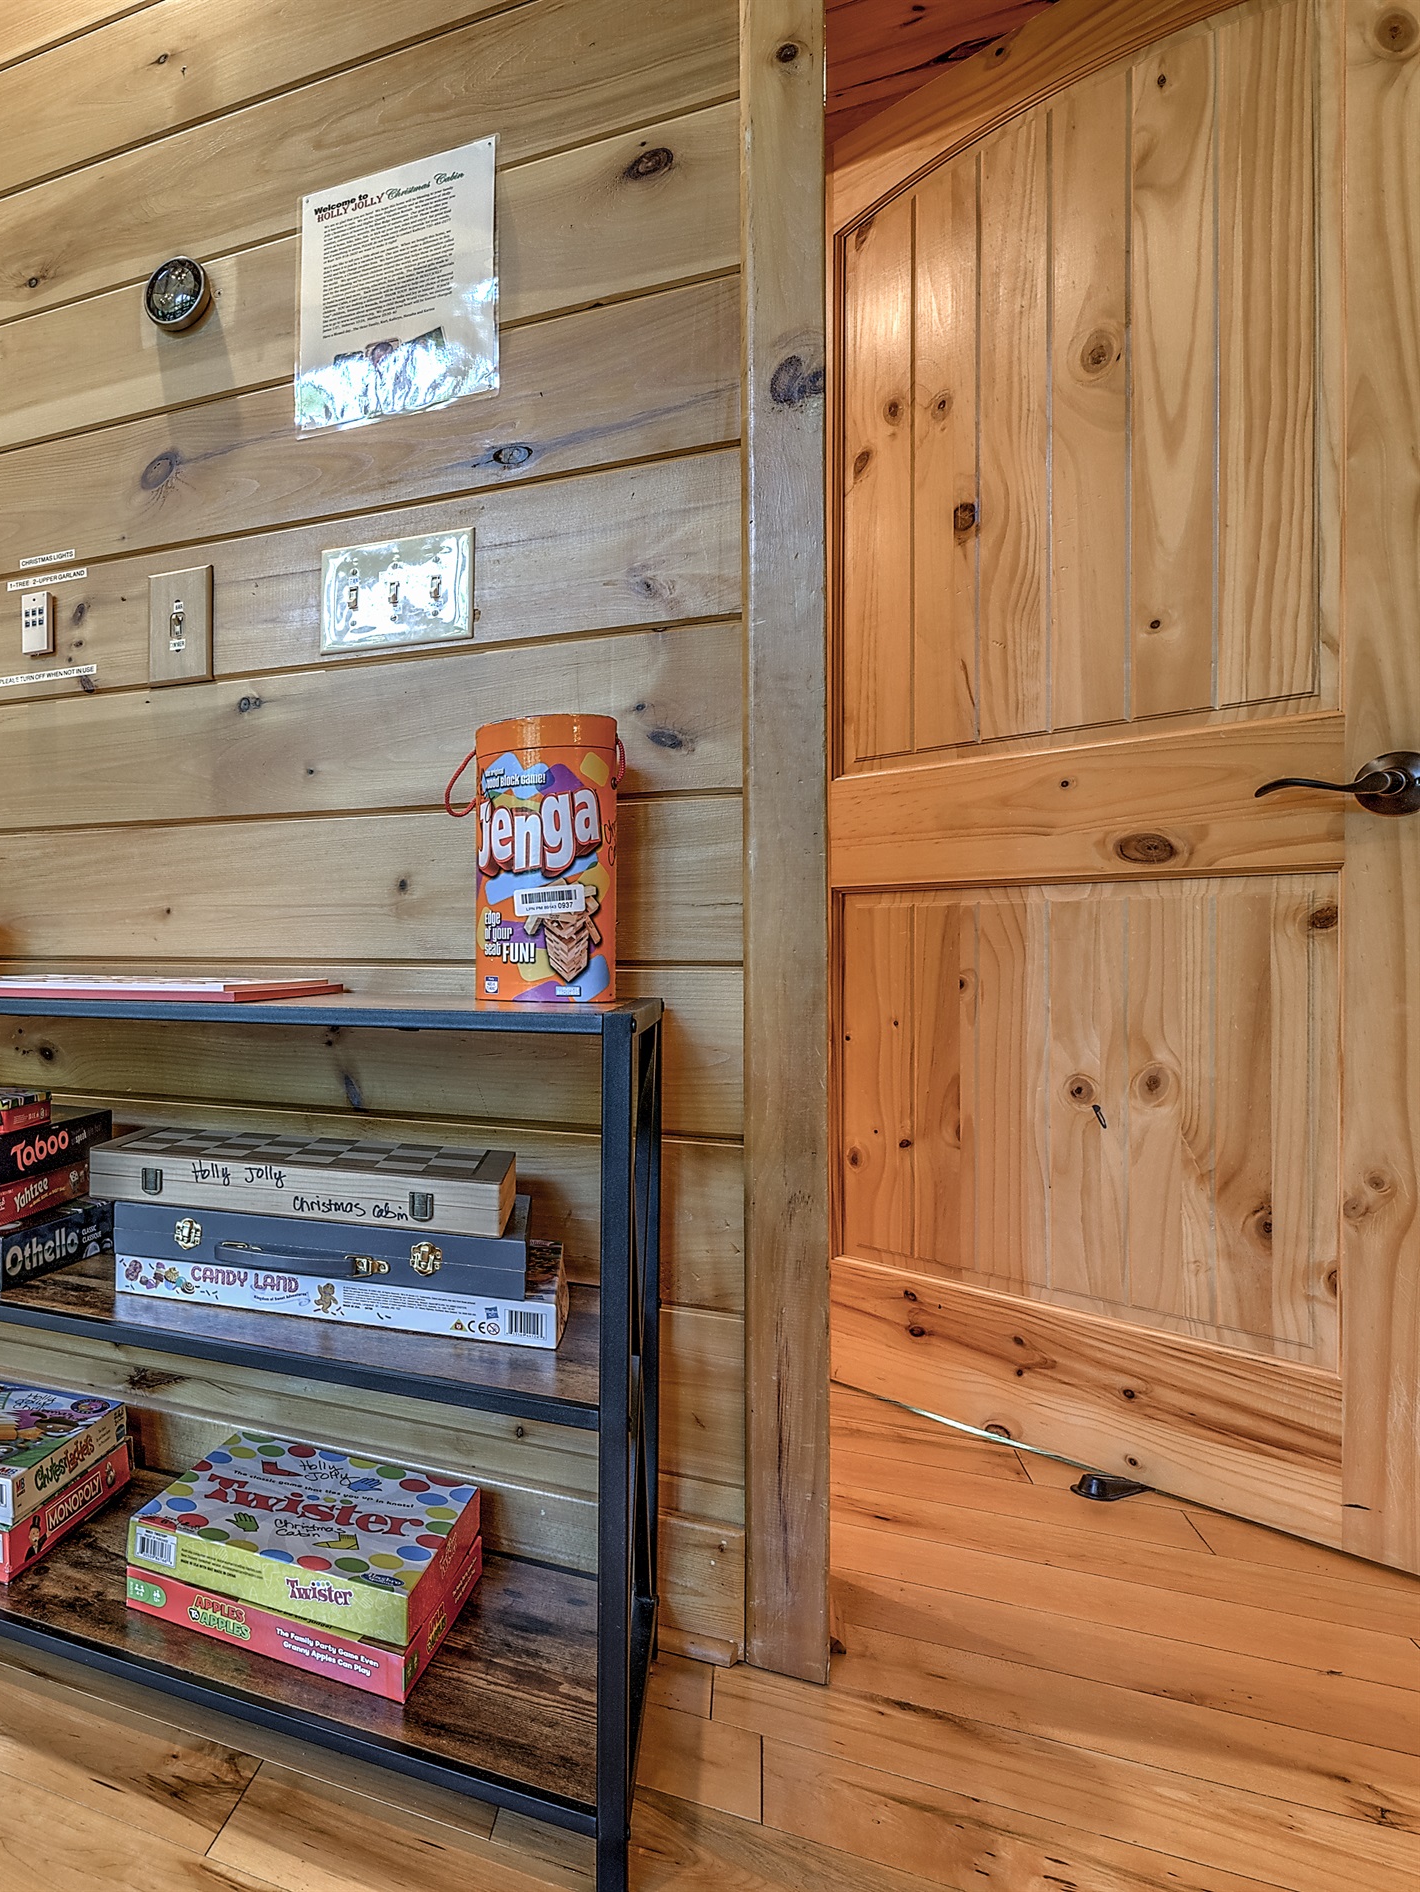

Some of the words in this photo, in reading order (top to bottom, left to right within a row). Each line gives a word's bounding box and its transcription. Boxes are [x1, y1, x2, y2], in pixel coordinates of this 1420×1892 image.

[313, 197, 356, 216] Welcome
[358, 192, 369, 201] to
[317, 205, 350, 223] HOLLY
[351, 192, 385, 212] JOLLY
[386, 181, 431, 201] Christmas
[433, 171, 465, 185] Cabin
[21, 555, 53, 567] CHRISTMAS
[53, 550, 74, 561] LIGHTS
[9, 579, 30, 589] 1-TREE
[58, 569, 85, 580] GARLAND
[20, 674, 35, 682] TURN
[35, 672, 46, 680] OFF
[46, 670, 64, 679] WHEN
[63, 668, 76, 676] NOT
[82, 665, 95, 674] USE
[478, 788, 601, 874] Jenga
[484, 910, 501, 927] Edge
[557, 901, 574, 909] 0937
[484, 925, 493, 940] of
[492, 927, 513, 942] your
[484, 941, 501, 956] seat
[502, 942, 535, 963] FUN!
[10, 1130, 69, 1172] Taboo
[191, 1159, 232, 1187] Holly
[244, 1165, 287, 1189] Jolly
[13, 1177, 49, 1213] Yahtzee
[292, 1195, 367, 1217] Christmas
[81, 1224, 97, 1236] CLASSIC
[81, 1231, 102, 1244] CLASSIQUE
[5, 1227, 79, 1277] Othello
[190, 1265, 249, 1288] CANDY
[253, 1272, 300, 1293] LAND
[34, 1456, 66, 1491] Chutes
[65, 1433, 95, 1474] Ladders
[299, 1459, 344, 1474] Holly
[48, 1475, 101, 1531] MONOPOLY
[233, 1469, 248, 1477] The
[249, 1474, 276, 1484] classic
[278, 1480, 303, 1488] game
[386, 1500, 415, 1509] knots!
[203, 1472, 426, 1538] Twister
[274, 1518, 347, 1534] Christmas
[275, 1528, 321, 1538] Cabin
[285, 1578, 353, 1606] Twister
[194, 1595, 247, 1623] APPLES
[200, 1610, 251, 1641] APPLES
[275, 1627, 290, 1639] The
[290, 1632, 315, 1647] Family
[314, 1639, 338, 1655] Party
[337, 1647, 360, 1661] Game
[360, 1655, 380, 1668] Even
[282, 1640, 310, 1657] Granny
[310, 1649, 337, 1665] Apples
[337, 1658, 353, 1670] Can
[353, 1663, 371, 1677] Play
